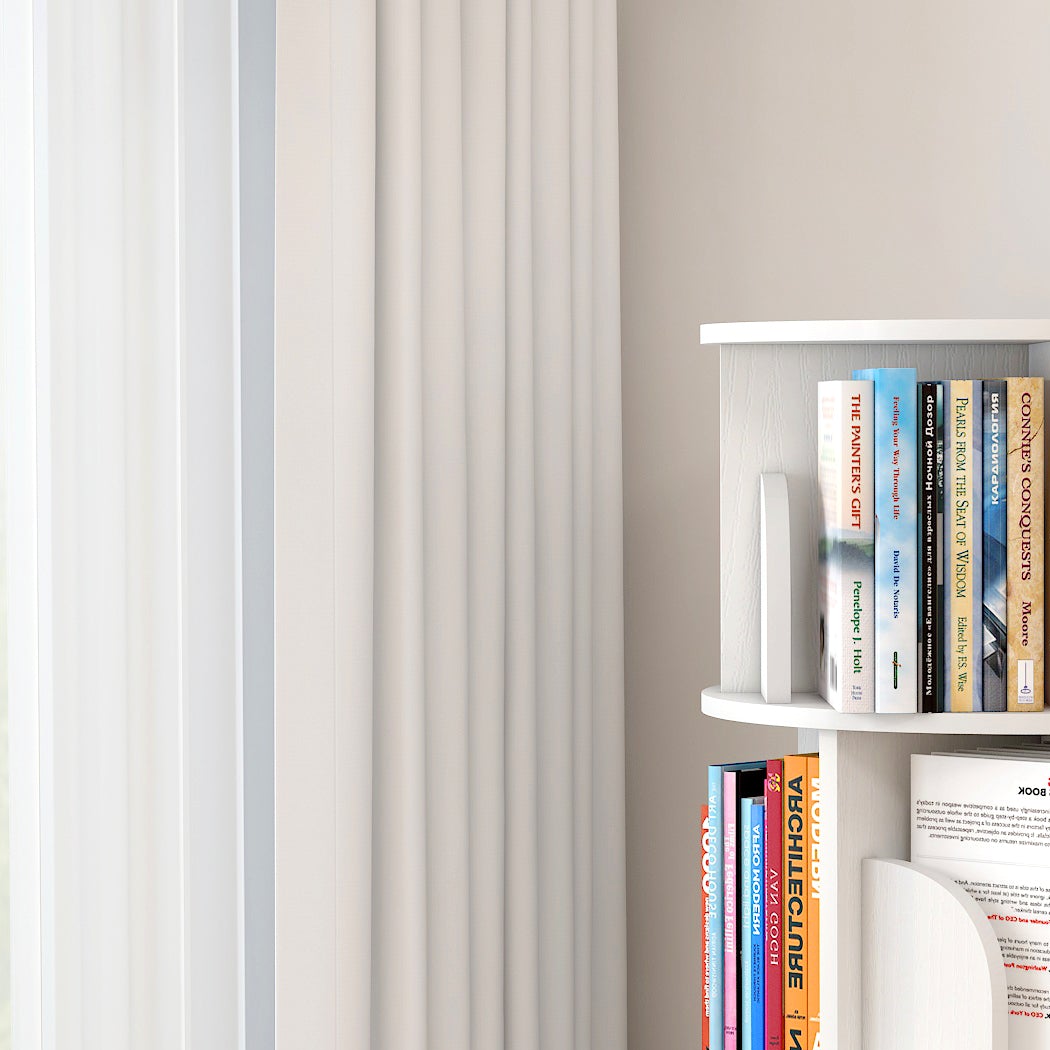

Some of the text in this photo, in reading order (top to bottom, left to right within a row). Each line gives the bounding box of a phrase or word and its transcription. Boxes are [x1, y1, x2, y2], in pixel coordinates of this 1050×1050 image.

[926, 395, 934, 437] Дозор
[851, 394, 861, 528] THE PAINTER'S GIFT
[892, 396, 900, 520] Feeling Your Way Through Life
[926, 495, 934, 542] взрослых
[956, 398, 969, 598] PEARLS FROM THE SEAT OF WISDOM
[1019, 393, 1031, 646] CONNIE'S CONQUESTS Moore
[893, 576, 900, 587] De
[851, 581, 862, 633] Penelope
[956, 644, 967, 654] by
[958, 617, 967, 642] Edited
[854, 650, 862, 674] Holt
[958, 672, 967, 692] Wise
